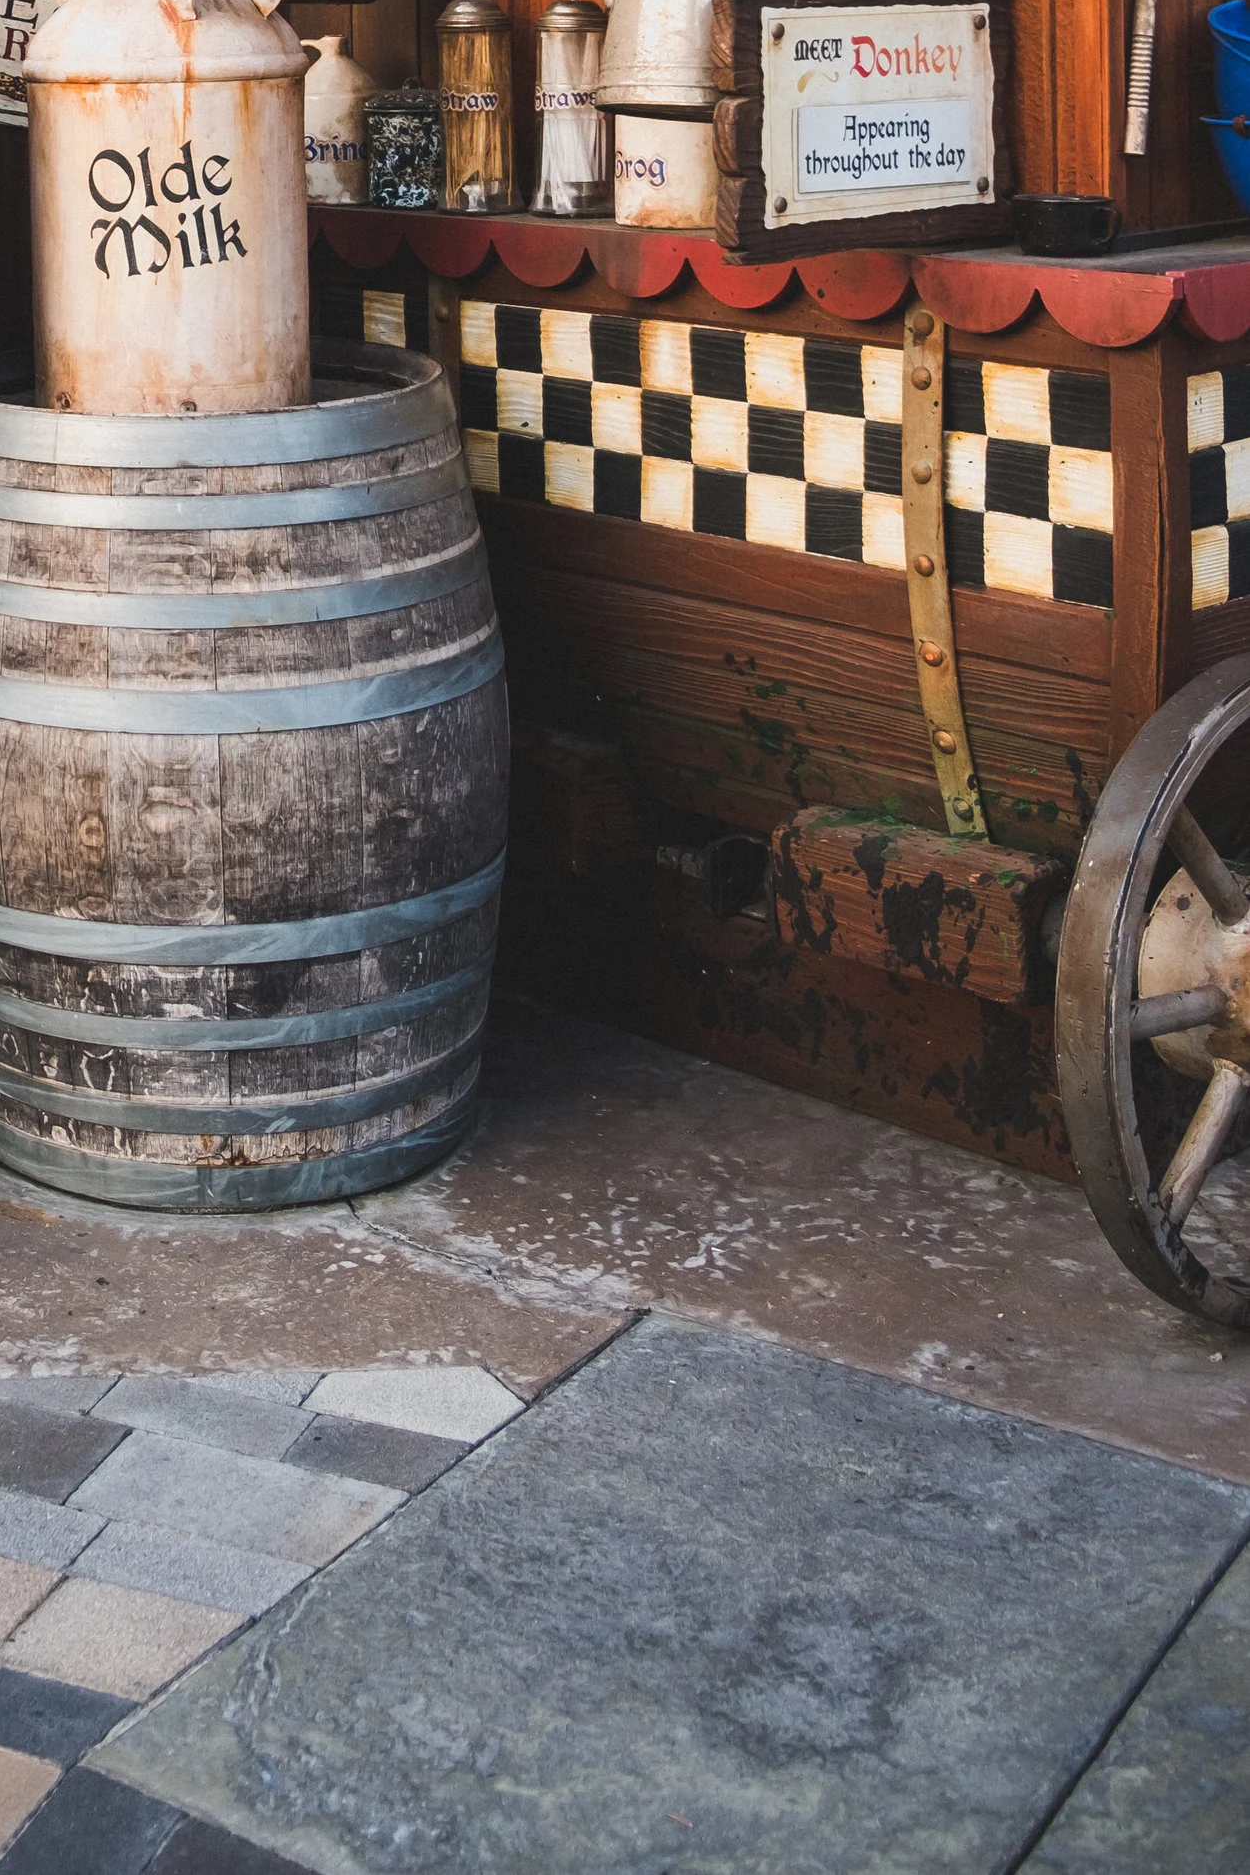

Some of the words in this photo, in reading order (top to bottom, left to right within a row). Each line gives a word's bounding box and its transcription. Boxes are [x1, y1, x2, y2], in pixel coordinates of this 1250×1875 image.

[793, 38, 843, 63] MEET
[850, 32, 963, 82] Donkey
[842, 113, 931, 146] Appearing
[88, 139, 233, 213] Olde
[804, 147, 900, 179] throughout
[908, 145, 932, 168] the
[935, 142, 966, 172] day
[90, 202, 249, 280] Milk
